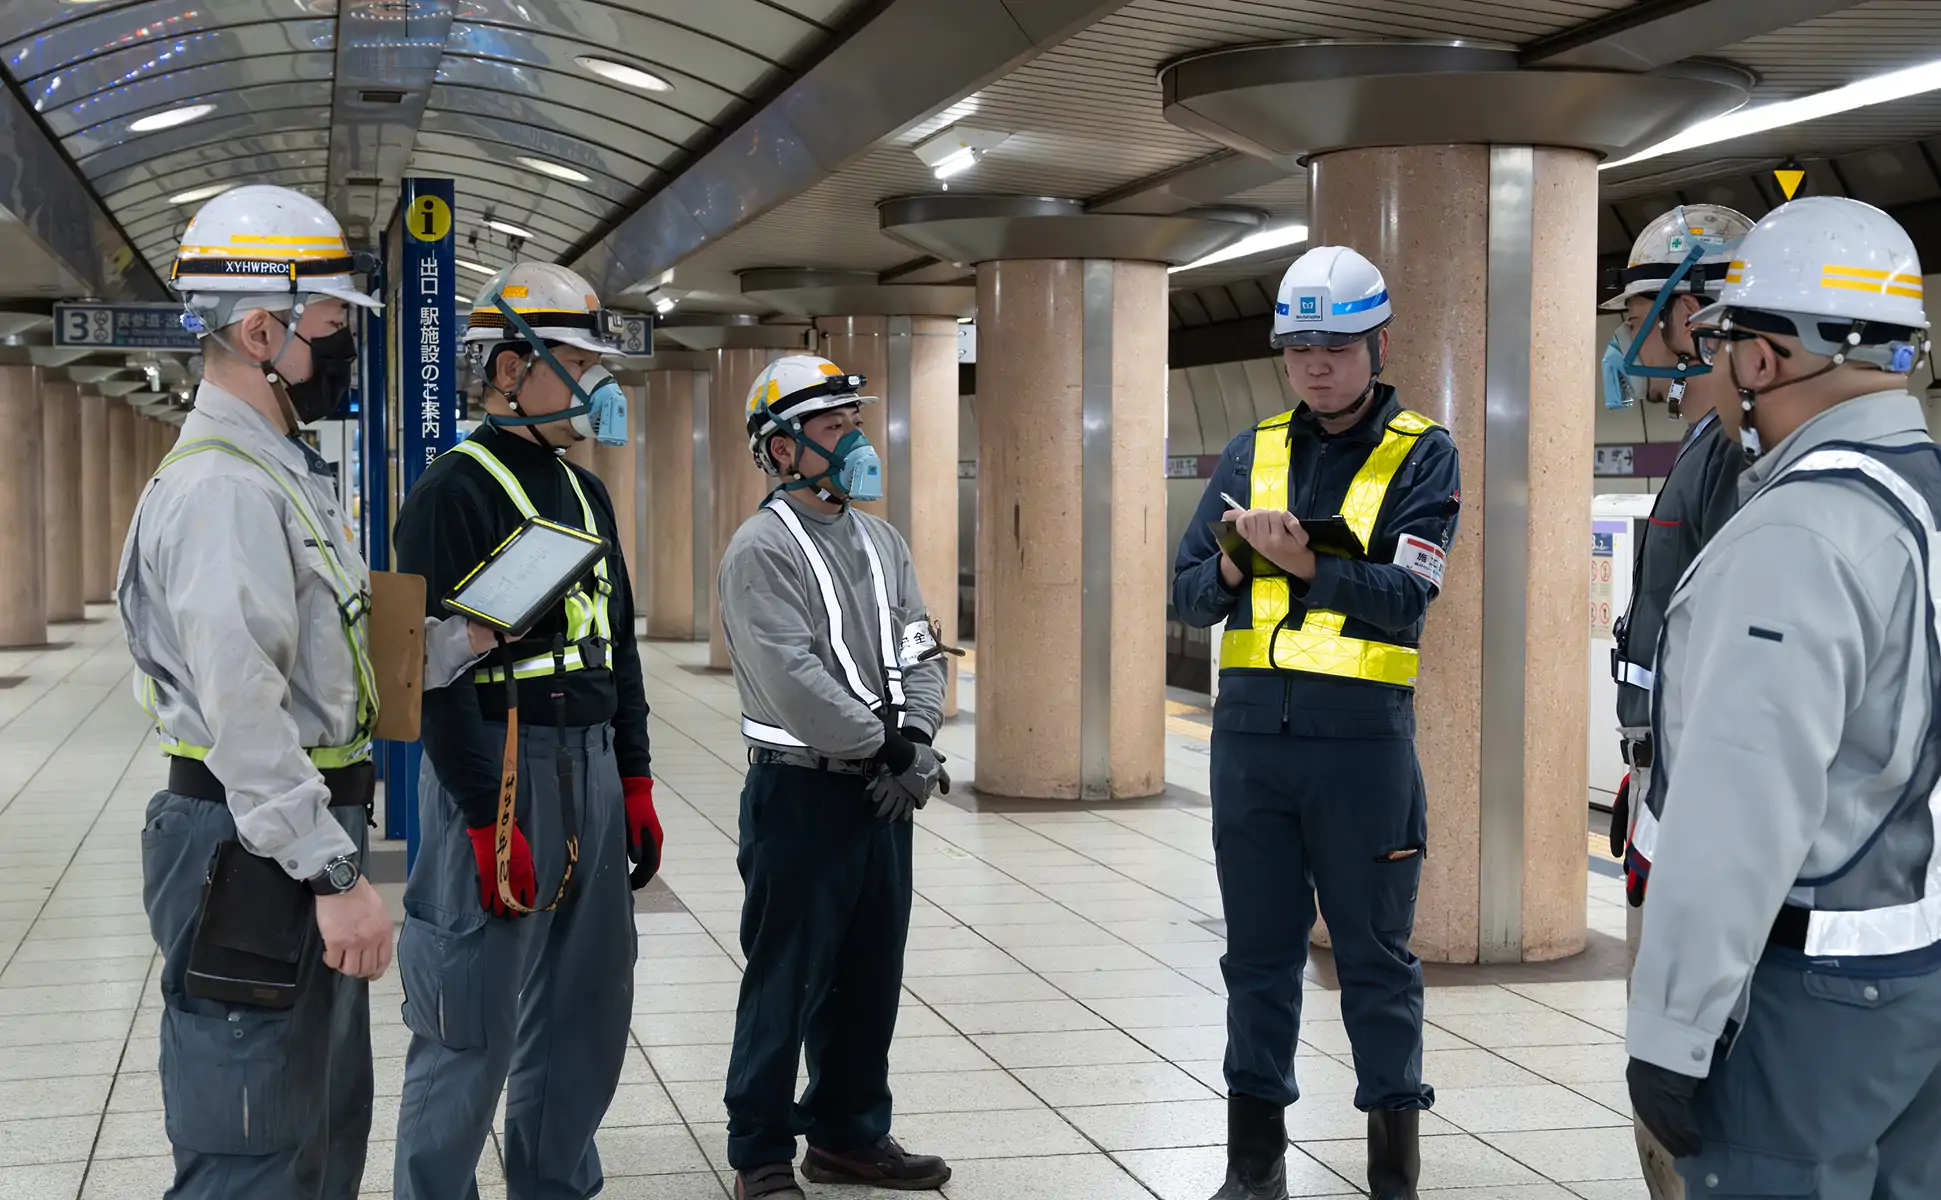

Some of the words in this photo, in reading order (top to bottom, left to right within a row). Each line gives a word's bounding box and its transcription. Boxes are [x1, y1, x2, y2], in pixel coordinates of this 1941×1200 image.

[69, 312, 89, 340] 3
[420, 257, 440, 438] 出口・駅施設のご案内
